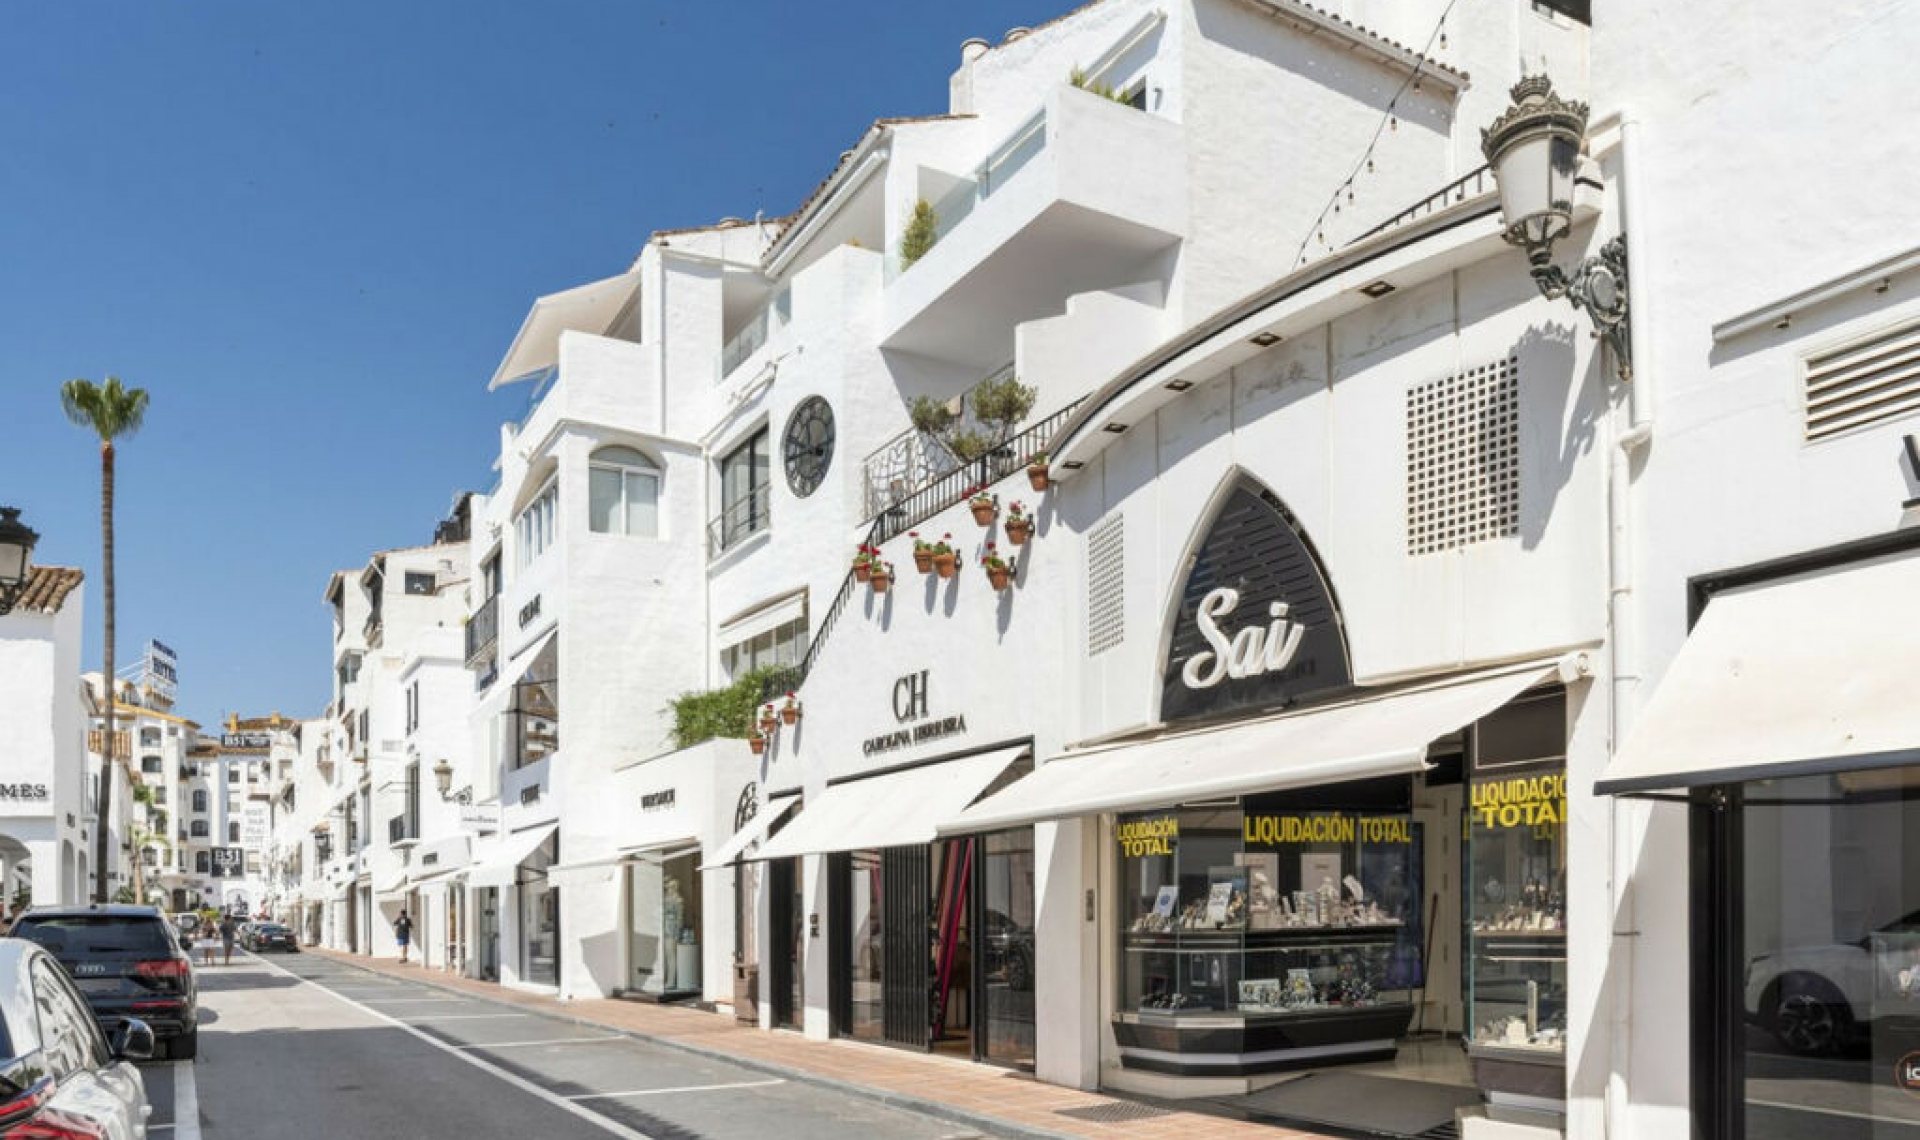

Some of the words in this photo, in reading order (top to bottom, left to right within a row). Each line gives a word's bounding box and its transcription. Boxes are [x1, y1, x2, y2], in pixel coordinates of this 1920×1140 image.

[1183, 587, 1305, 688] Sai
[892, 669, 930, 723] CH
[1123, 838, 1172, 857] TOTAL
[1245, 812, 1354, 845] LIQUIDACIÓN
[1360, 817, 1411, 843] TOTAL
